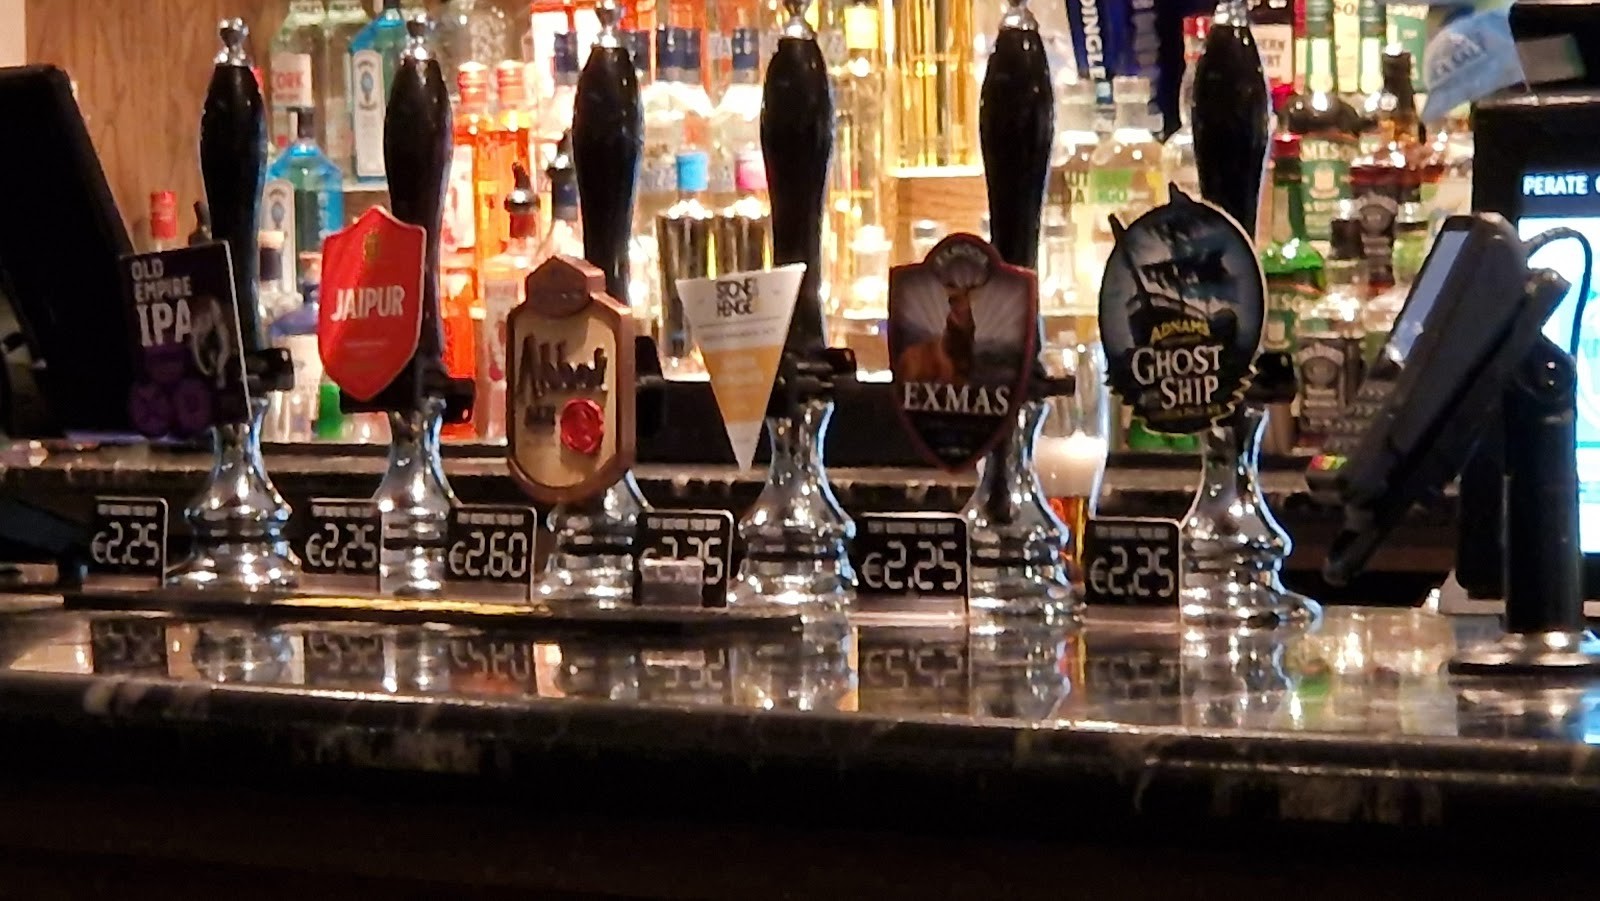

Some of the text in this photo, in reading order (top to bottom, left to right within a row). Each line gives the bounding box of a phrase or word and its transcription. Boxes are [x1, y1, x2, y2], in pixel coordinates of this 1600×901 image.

[131, 258, 165, 281] OLD
[133, 276, 193, 302] EMPIRE
[330, 285, 406, 322] JAIPUR
[136, 299, 192, 347] IPA
[1131, 345, 1224, 386] GHOST
[902, 381, 1012, 417] EXMAS
[1160, 375, 1220, 411] SHIP
